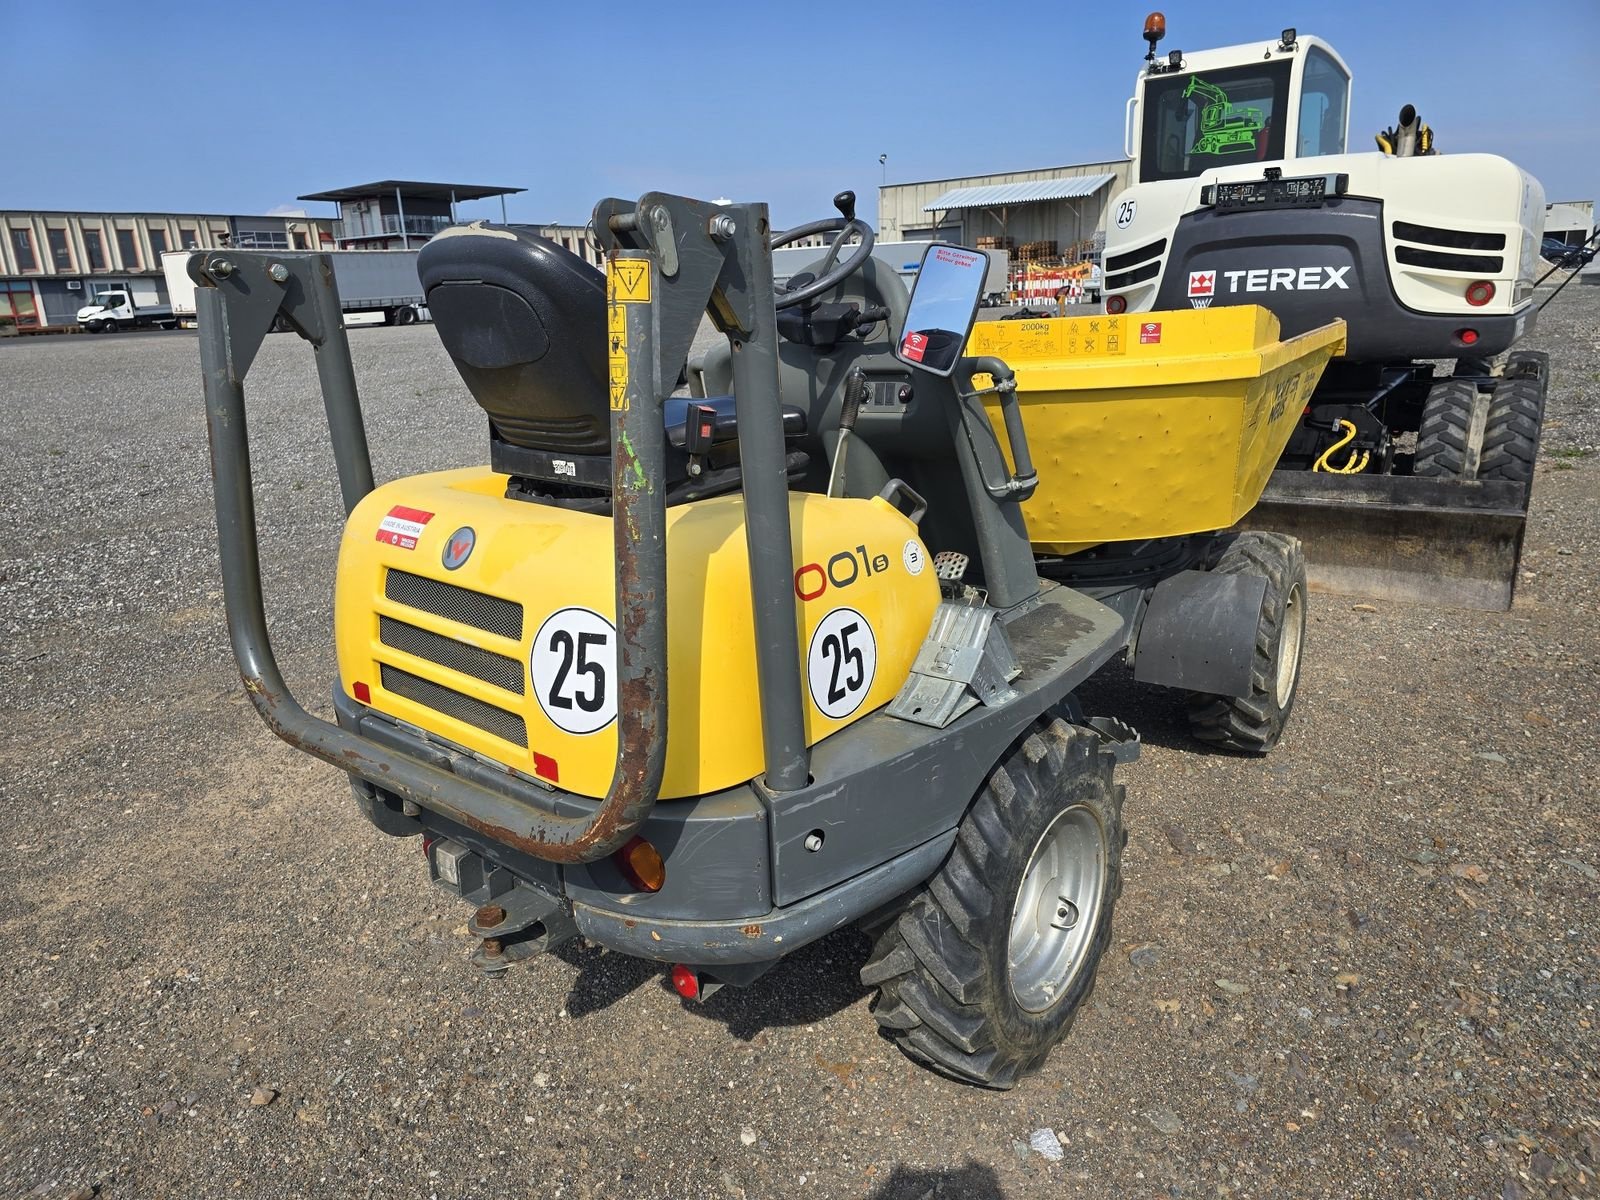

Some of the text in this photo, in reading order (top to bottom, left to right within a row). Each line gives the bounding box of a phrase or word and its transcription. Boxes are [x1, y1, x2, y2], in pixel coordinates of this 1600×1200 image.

[1118, 201, 1135, 224] 25
[936, 255, 972, 268] Retour geben
[1224, 266, 1351, 293] TEREX
[1021, 323, 1050, 332] 2000kg
[401, 524, 421, 534] AUSTRIA
[549, 629, 607, 713] 25
[821, 622, 865, 706] 25
